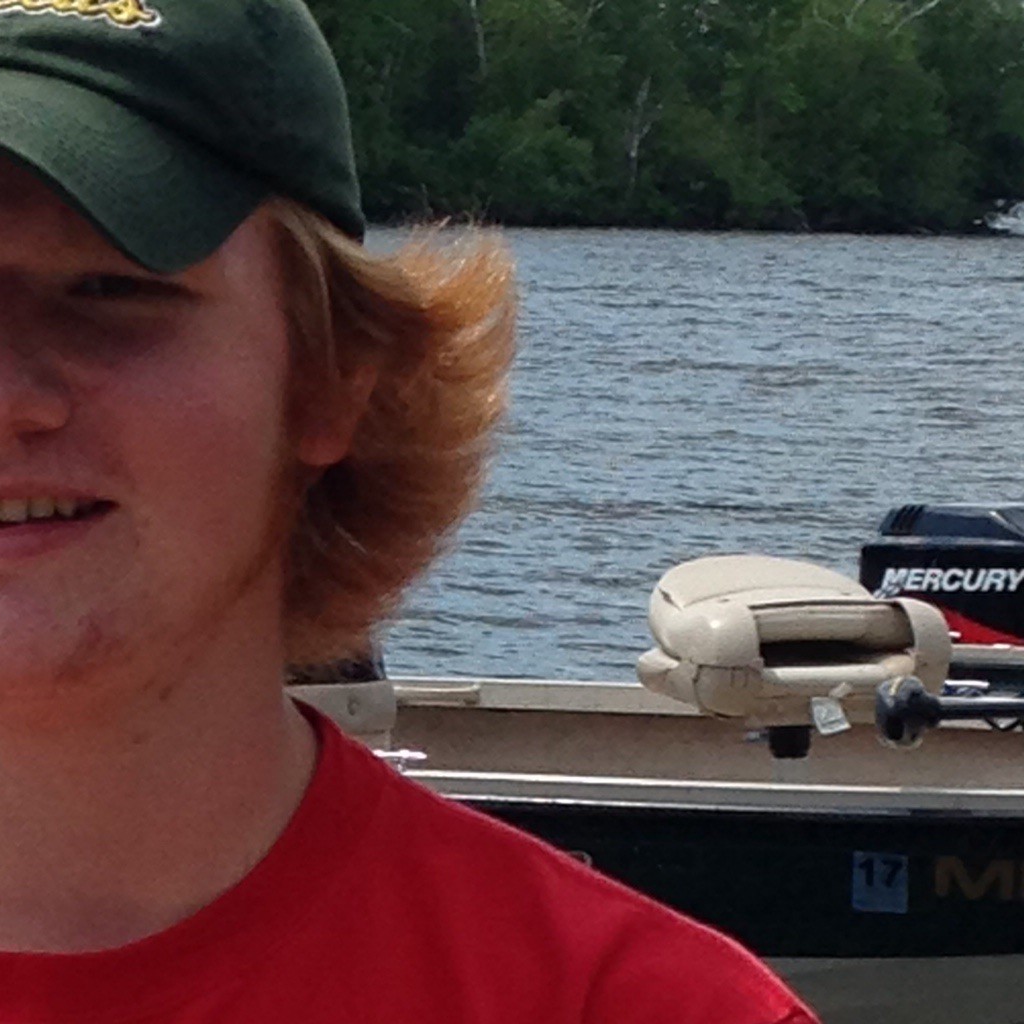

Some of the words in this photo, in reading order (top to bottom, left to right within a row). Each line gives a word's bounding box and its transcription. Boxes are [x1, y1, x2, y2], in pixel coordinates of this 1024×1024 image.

[874, 567, 1024, 599] MERCURY
[858, 857, 904, 888] 17
[934, 855, 1024, 900] M
